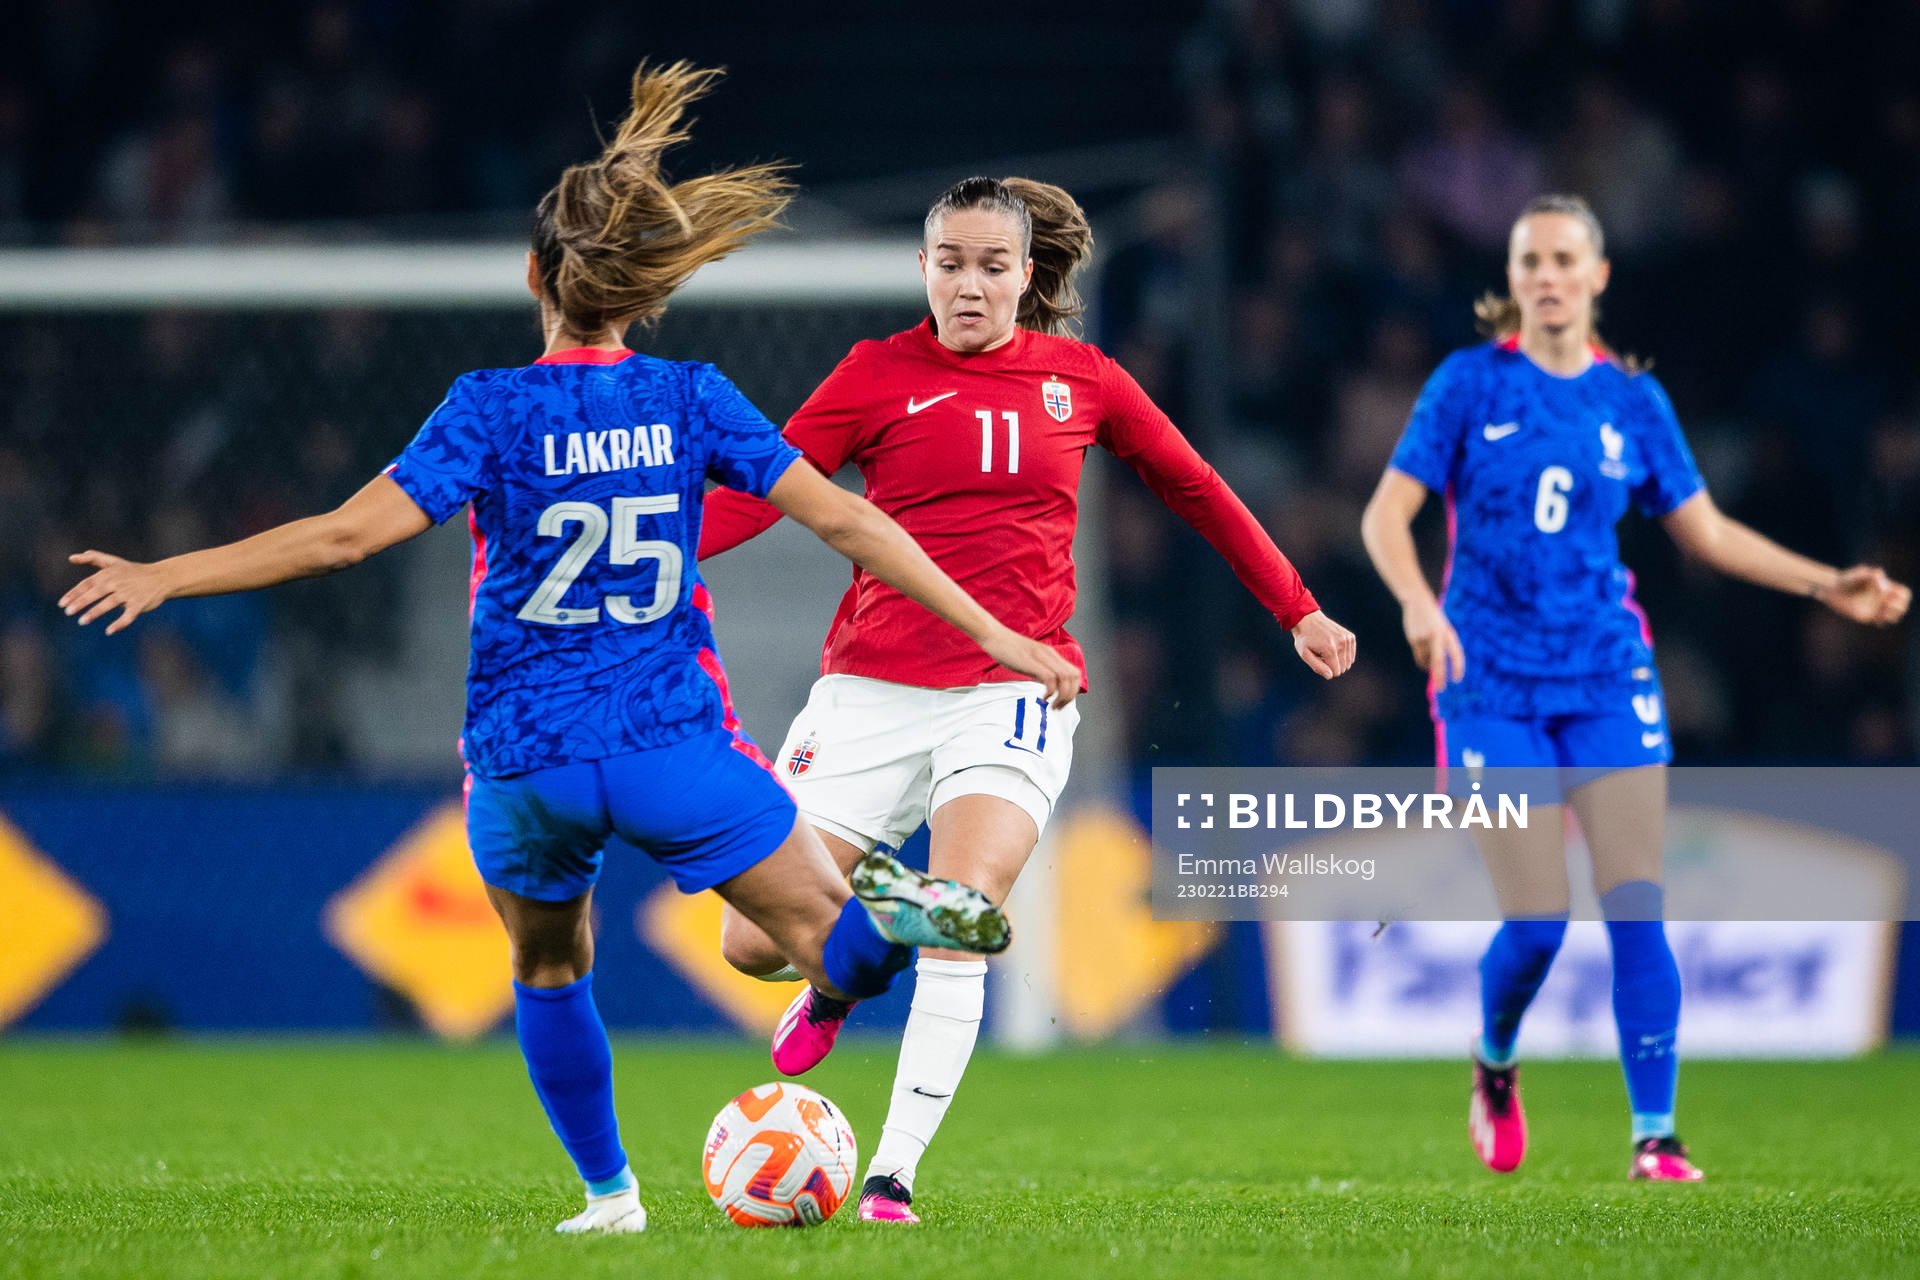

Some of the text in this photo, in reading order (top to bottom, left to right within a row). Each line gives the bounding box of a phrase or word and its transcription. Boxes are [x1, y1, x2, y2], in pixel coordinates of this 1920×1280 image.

[543, 423, 675, 476] LAKRAR
[975, 410, 1020, 474] 11
[1534, 465, 1574, 534] 6
[515, 493, 683, 625] 25
